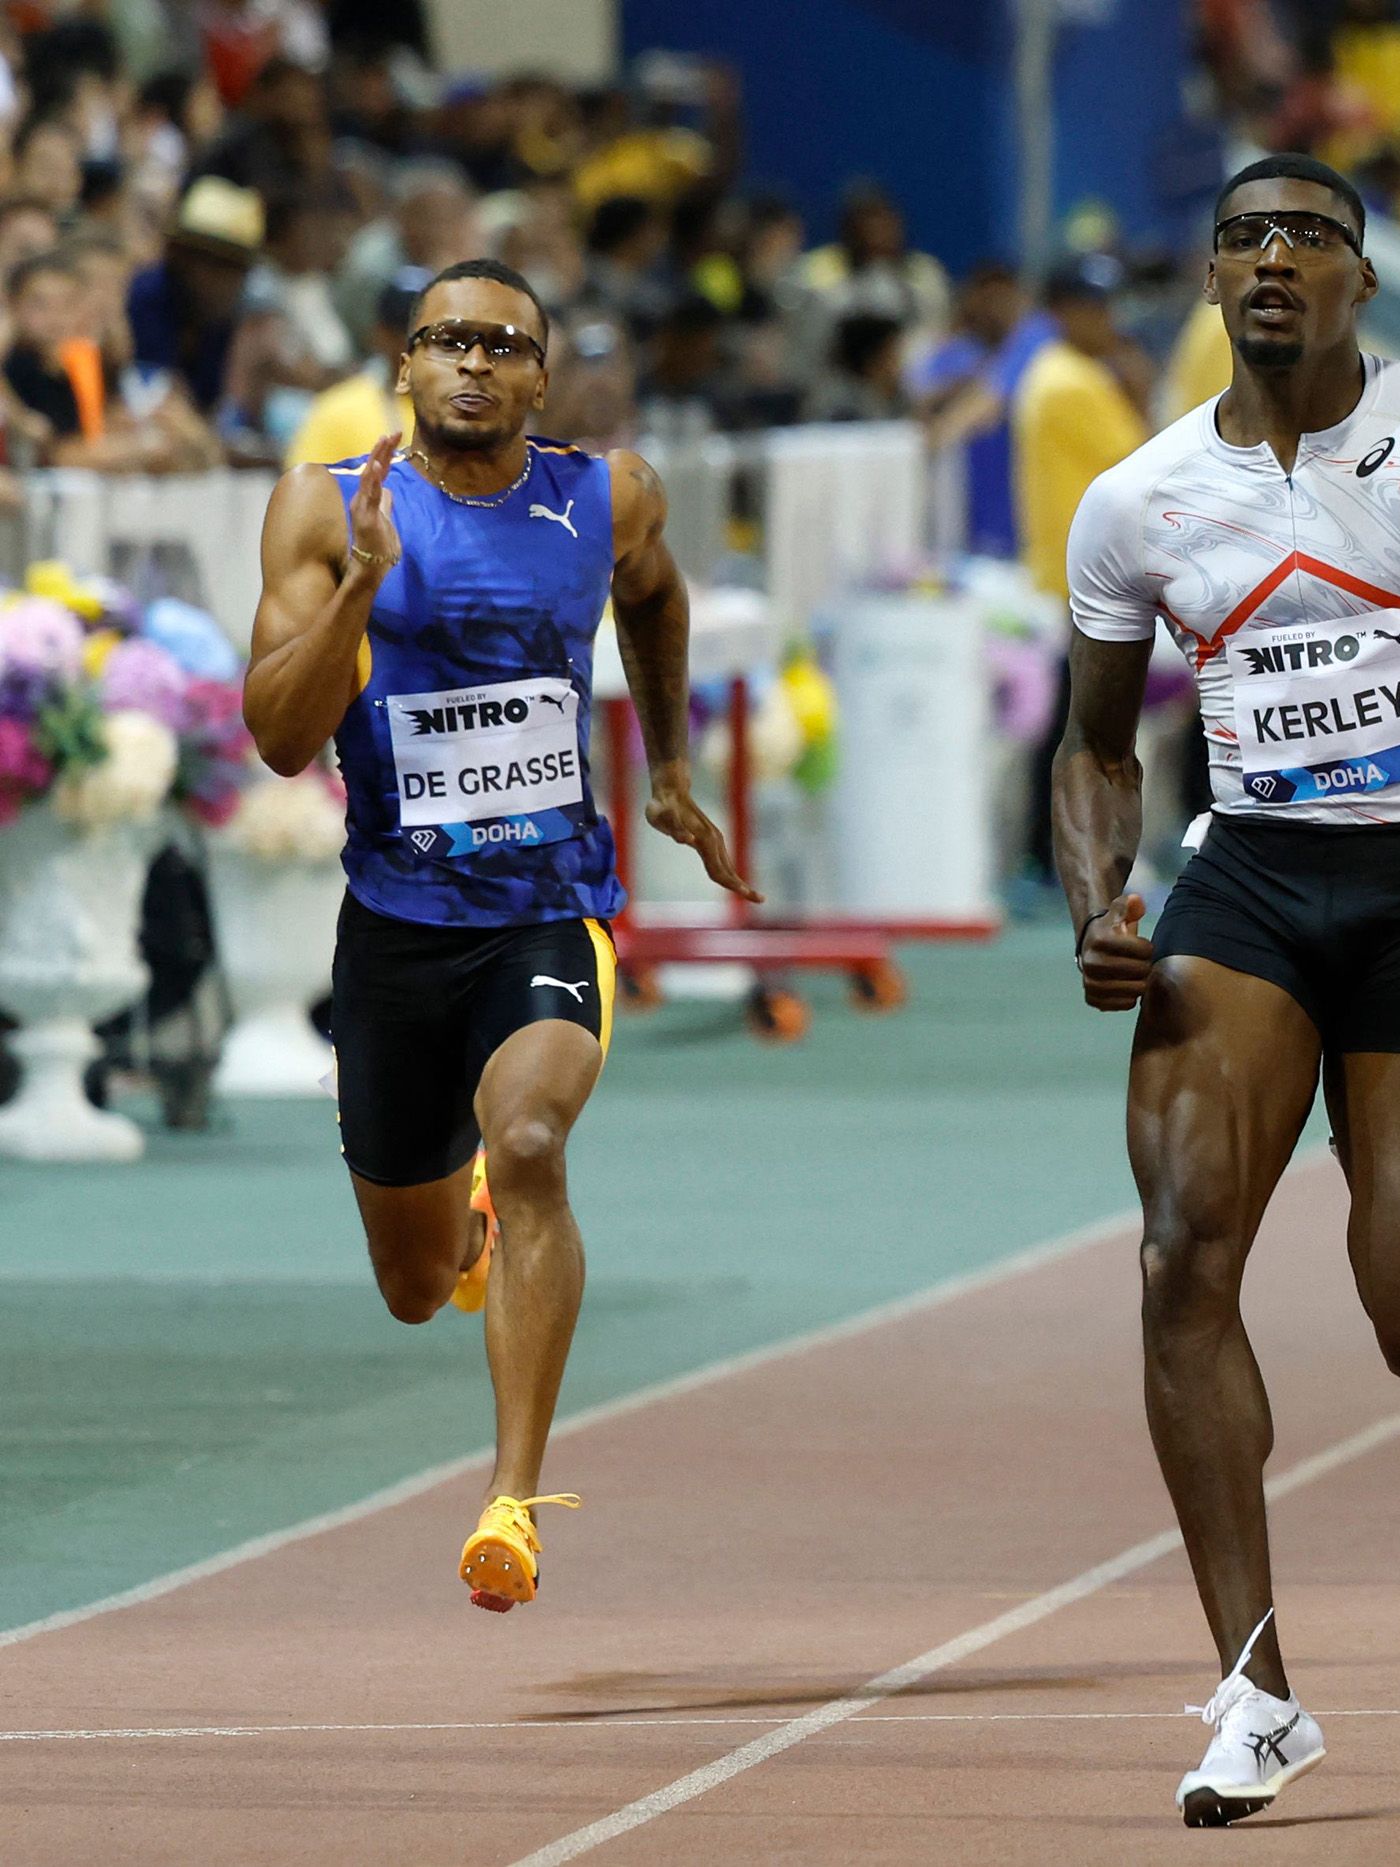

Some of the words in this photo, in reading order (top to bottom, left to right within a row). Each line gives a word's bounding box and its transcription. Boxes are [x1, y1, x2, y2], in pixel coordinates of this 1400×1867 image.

[1271, 633, 1303, 643] FUELED
[1305, 631, 1316, 639] BY
[446, 695, 476, 705] FUELED
[403, 771, 447, 800] DE
[458, 750, 575, 795] GRASSE
[1313, 763, 1384, 790] DOHA
[471, 821, 538, 845] DOHA
